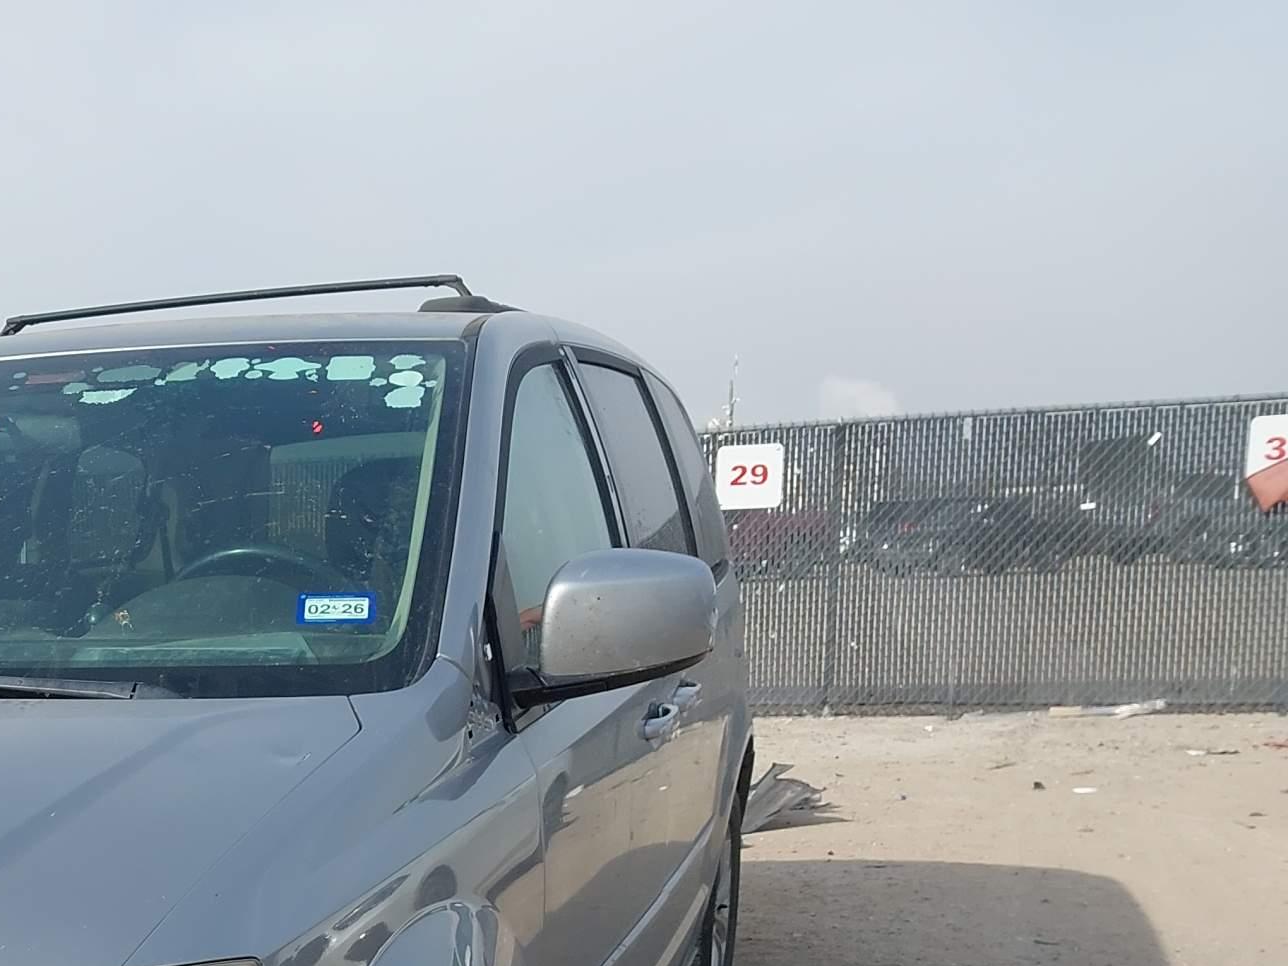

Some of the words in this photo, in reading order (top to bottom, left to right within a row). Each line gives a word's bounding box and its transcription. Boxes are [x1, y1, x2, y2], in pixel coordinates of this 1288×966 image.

[1264, 437, 1287, 461] 3
[730, 464, 769, 487] 29
[307, 603, 331, 615] 02
[341, 603, 365, 614] 26
